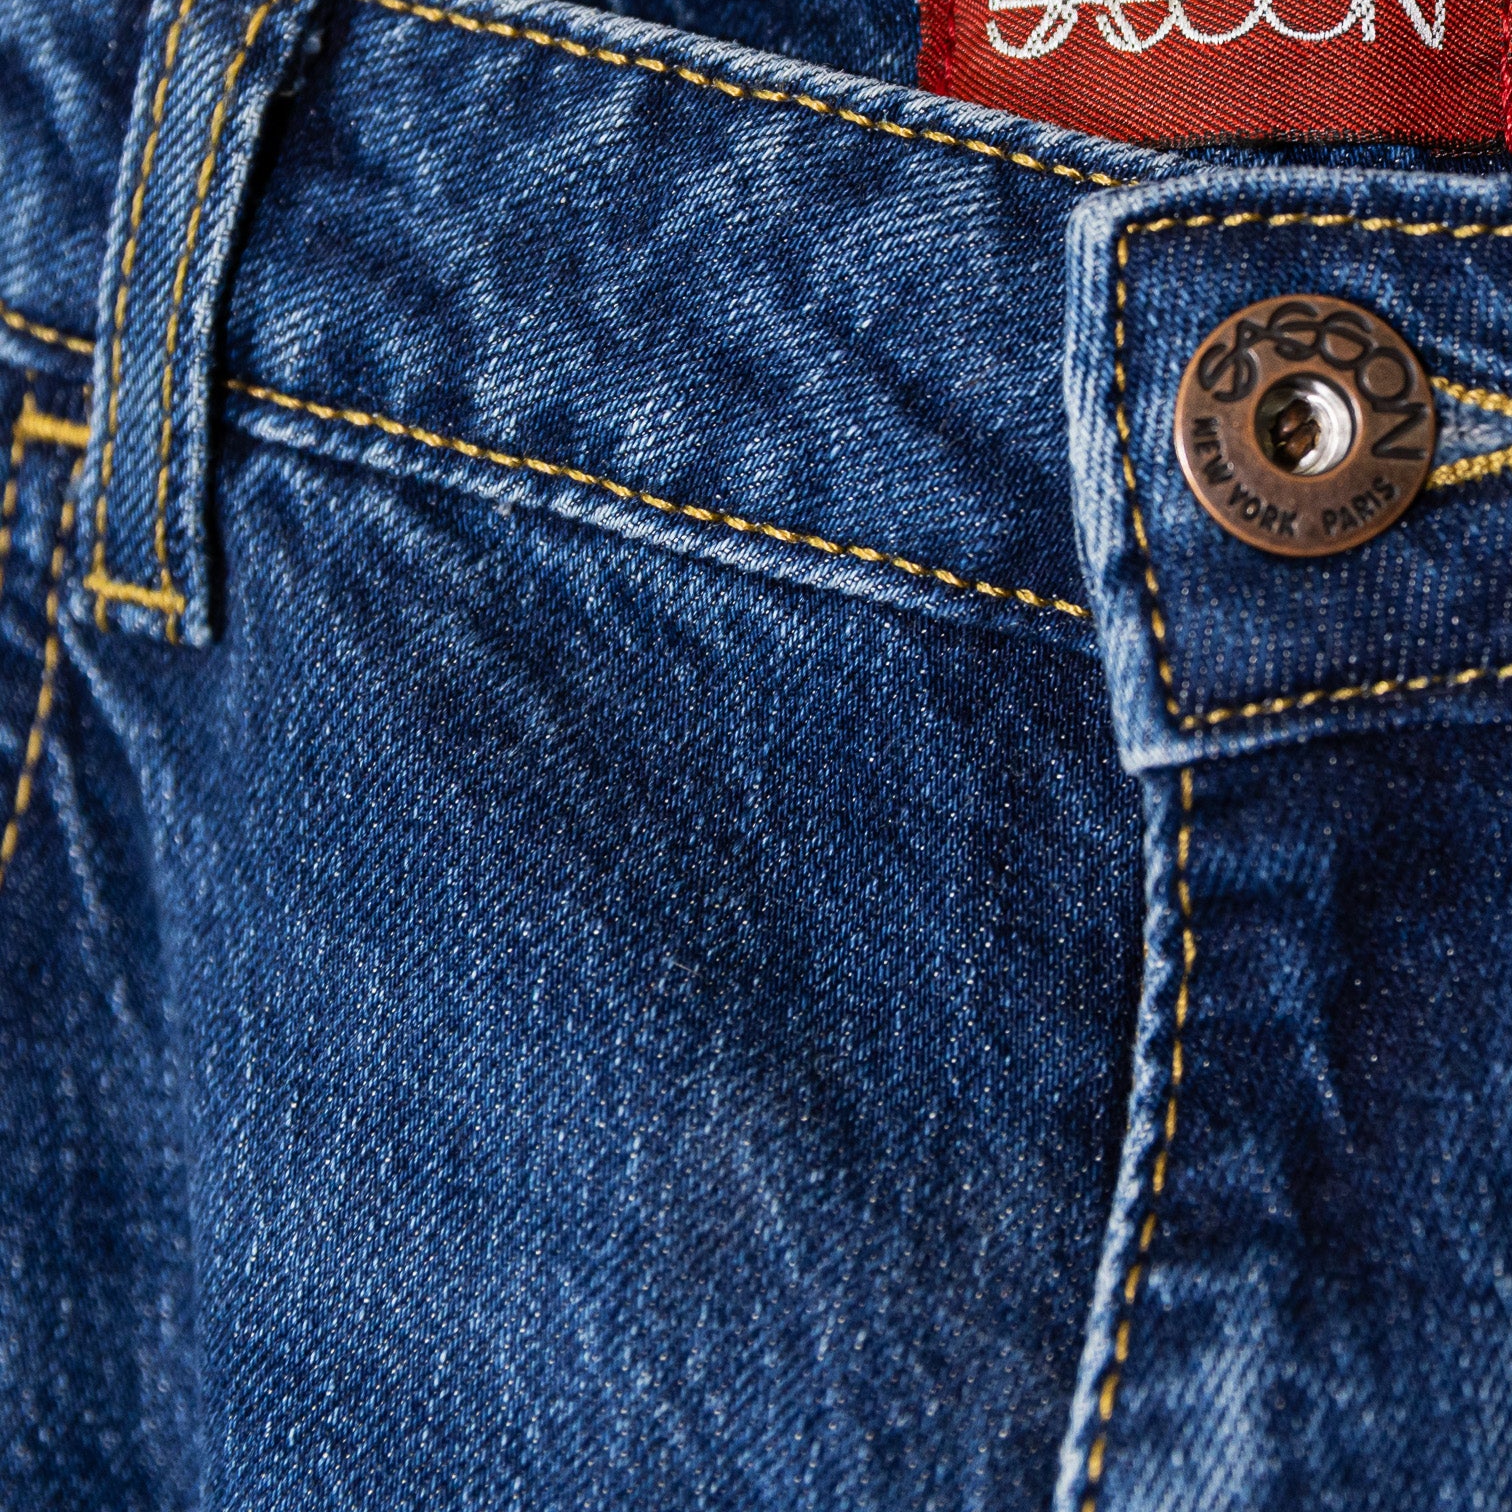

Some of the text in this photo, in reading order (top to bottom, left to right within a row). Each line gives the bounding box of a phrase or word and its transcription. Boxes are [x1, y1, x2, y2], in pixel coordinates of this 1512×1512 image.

[1192, 415, 1398, 537] NEW YORK PARIS
